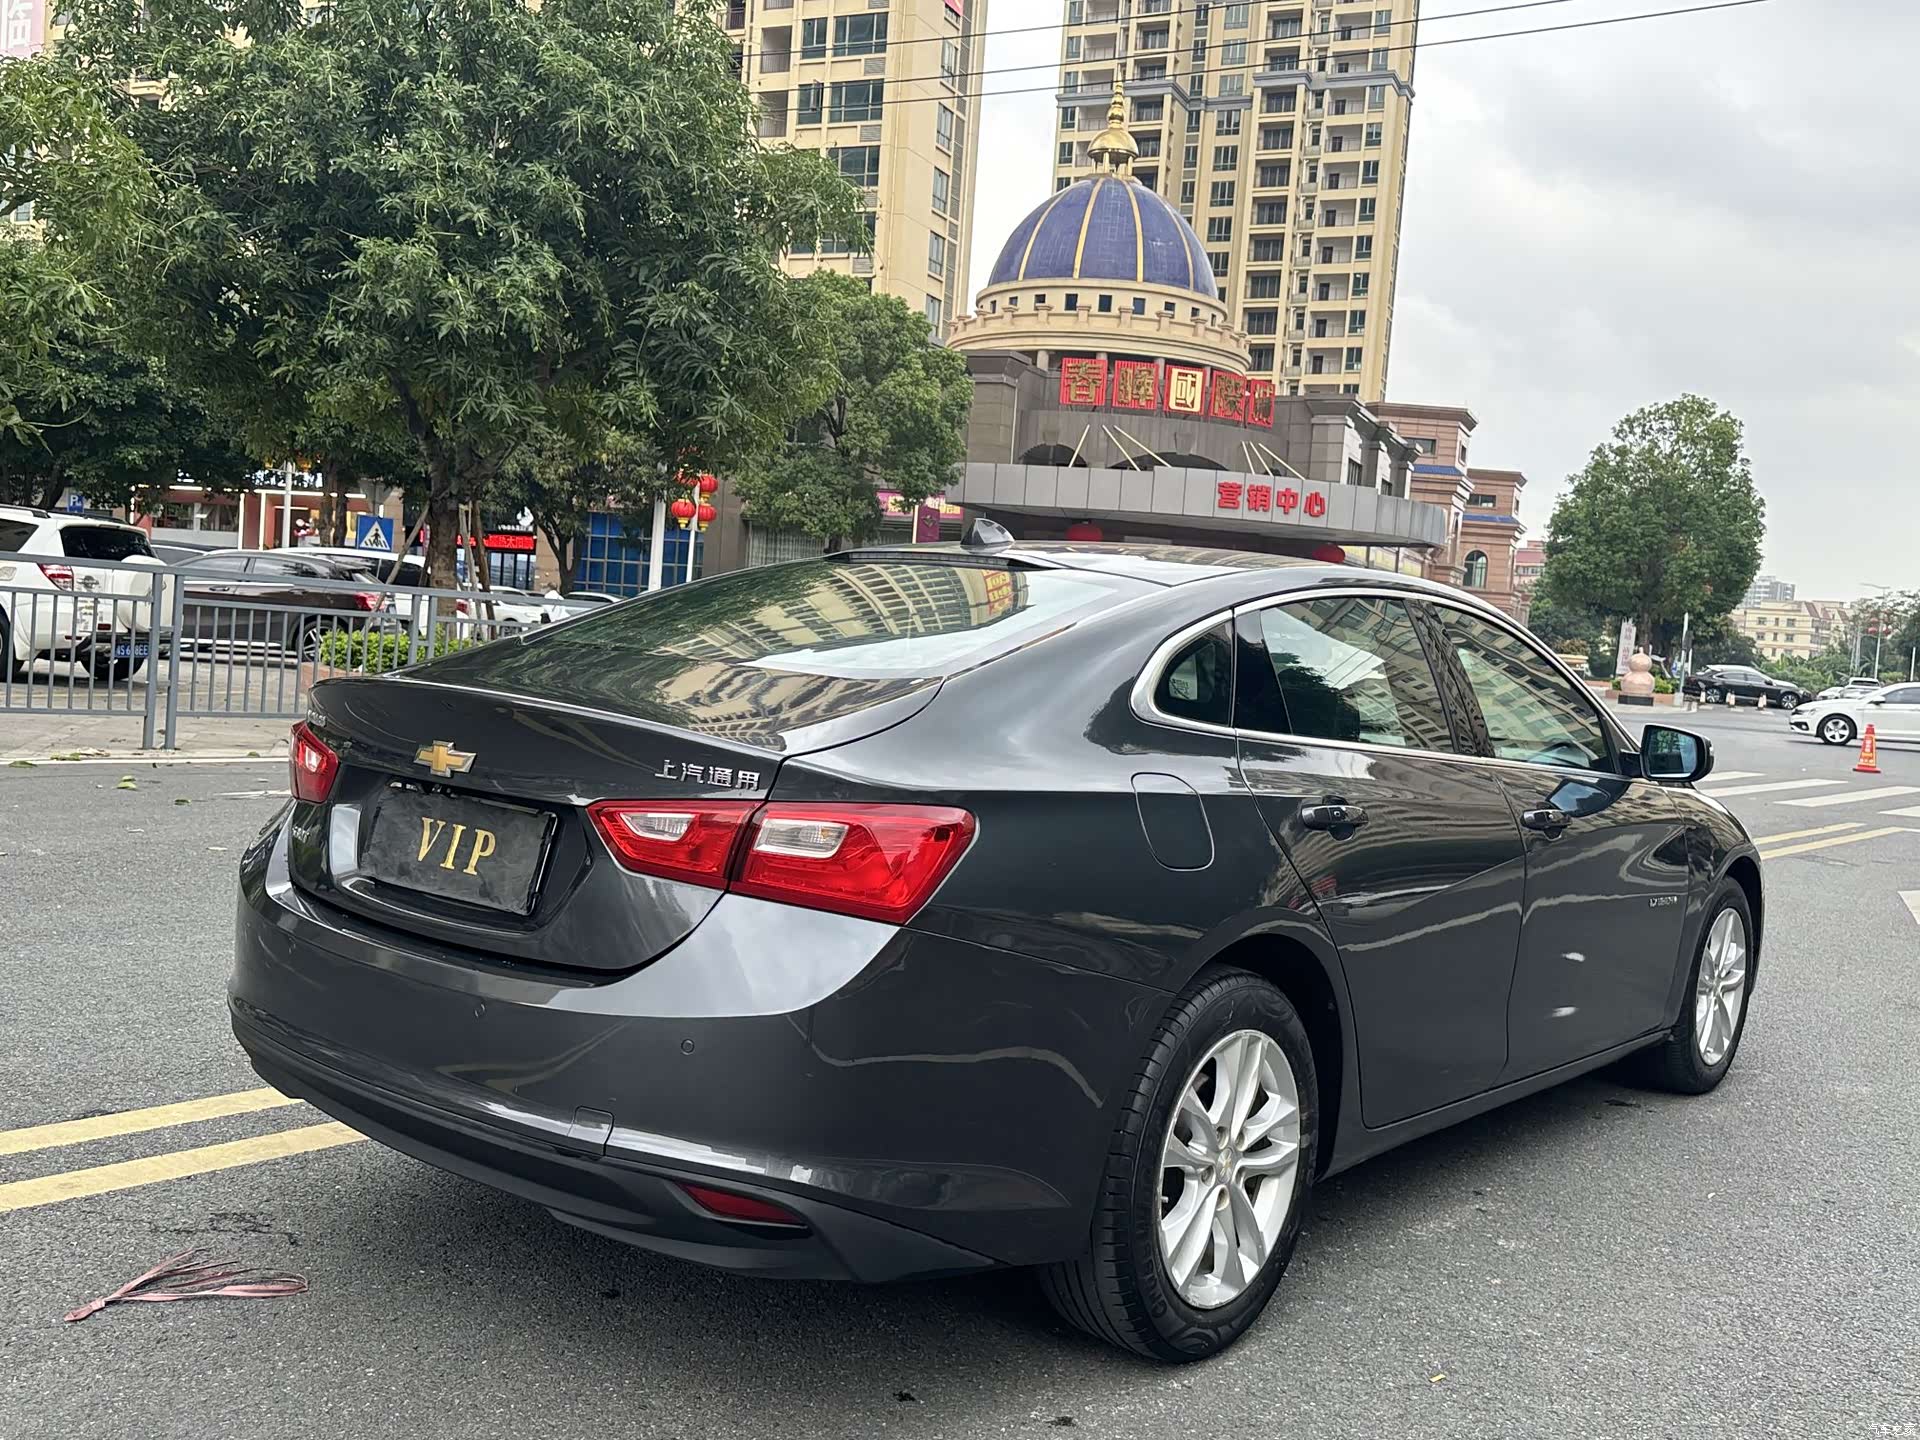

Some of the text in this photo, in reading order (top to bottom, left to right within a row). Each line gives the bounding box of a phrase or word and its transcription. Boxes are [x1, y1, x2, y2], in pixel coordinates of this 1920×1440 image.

[1217, 481, 1326, 518] 营销中心
[654, 759, 760, 792] 上汽通用
[417, 816, 497, 876] VIP
